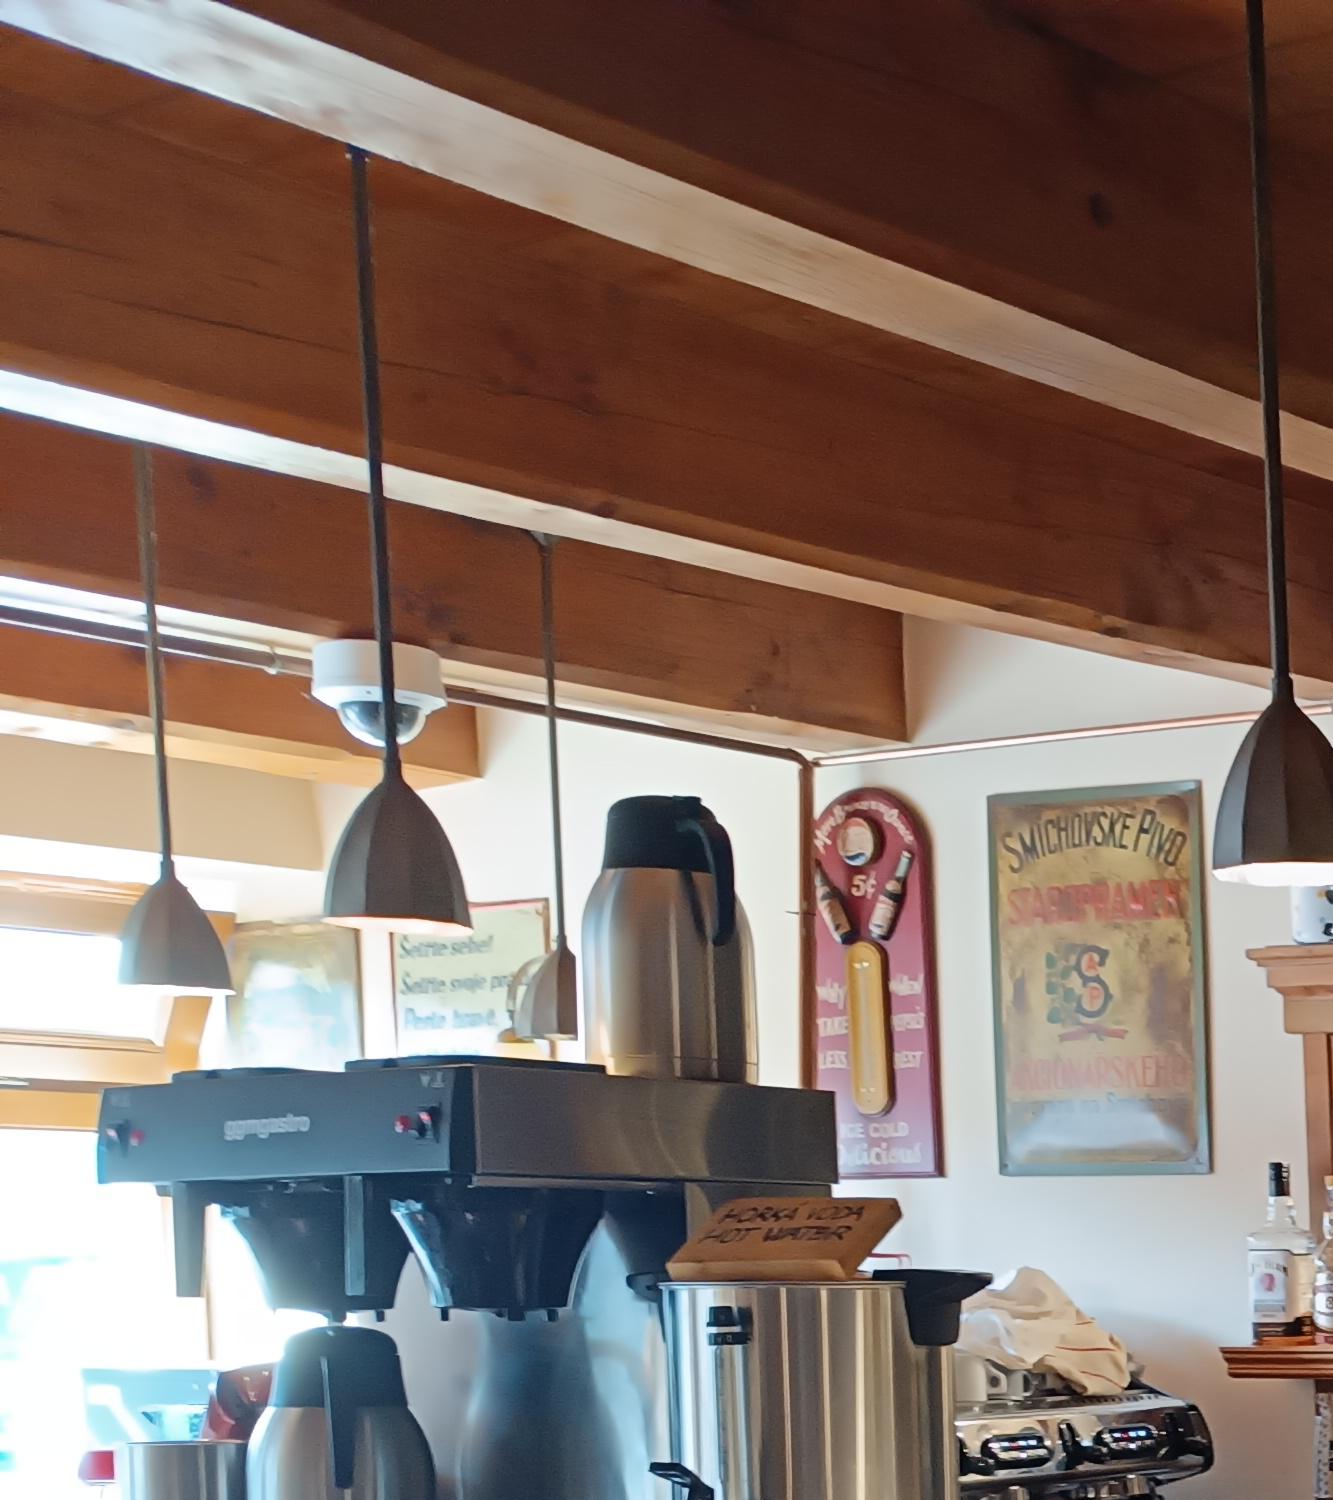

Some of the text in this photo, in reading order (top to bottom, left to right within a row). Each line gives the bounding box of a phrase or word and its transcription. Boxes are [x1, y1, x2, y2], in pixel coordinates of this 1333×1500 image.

[1132, 808, 1188, 867] PIVO
[869, 1121, 910, 1138] COLD
[806, 1206, 866, 1221] VODA
[698, 1225, 852, 1244] HOT WATER
